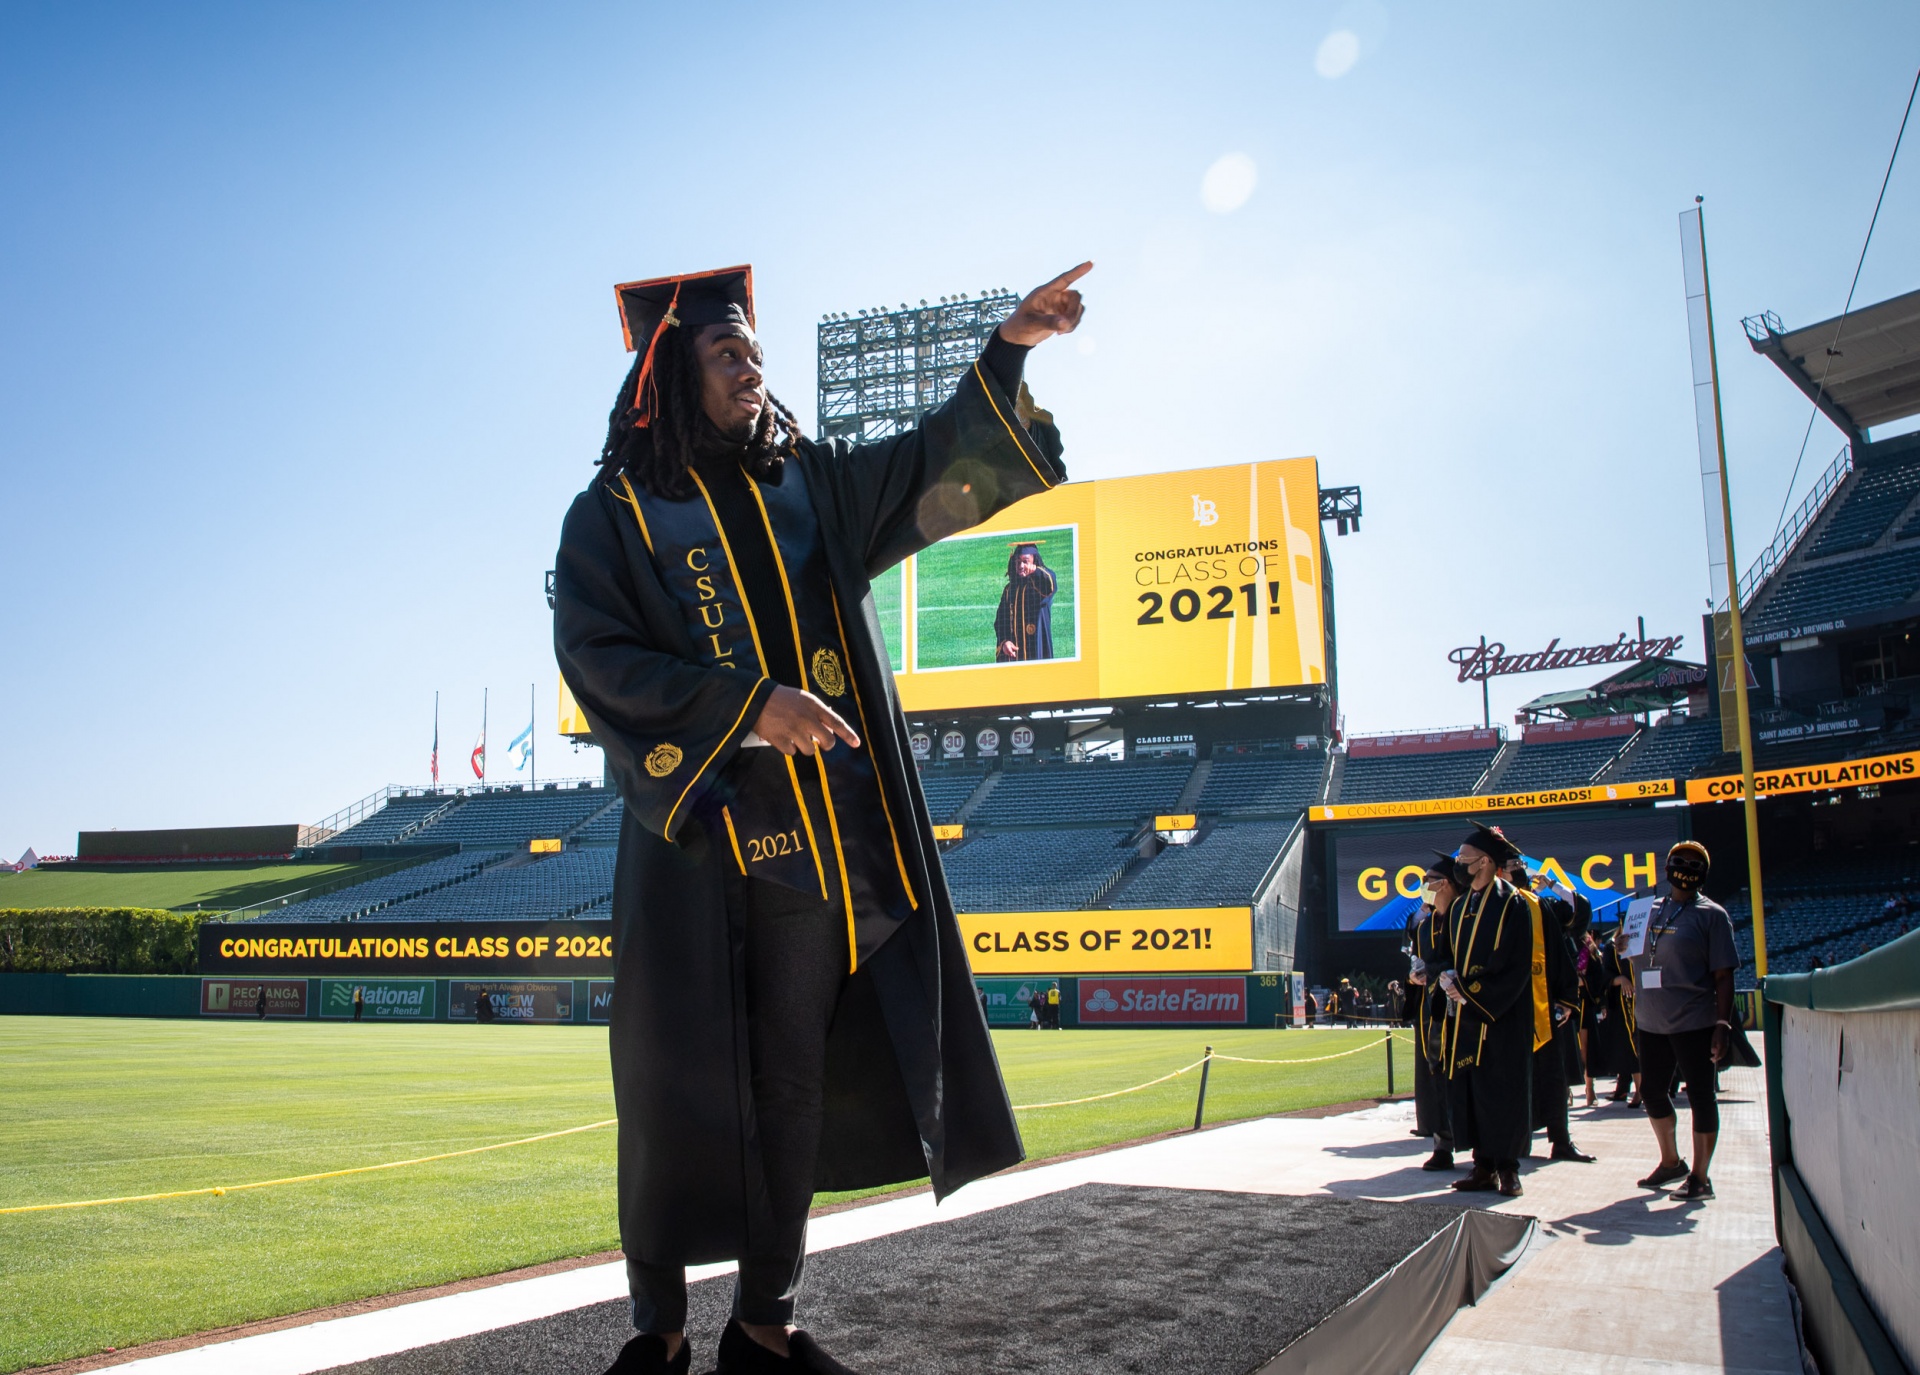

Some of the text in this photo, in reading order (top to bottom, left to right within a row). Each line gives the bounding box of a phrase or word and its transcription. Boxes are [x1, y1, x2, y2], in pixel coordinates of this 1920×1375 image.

[1135, 540, 1279, 562] CONGRATULATIONS
[1135, 554, 1279, 586] CLASS OF
[687, 548, 736, 669] CSUL
[1137, 581, 1280, 625] 2021!
[1745, 636, 1763, 646] SAINT
[1764, 630, 1789, 642] ARCHER
[1803, 624, 1833, 635] BREWING
[1448, 632, 1684, 682] Budweiser
[979, 733, 996, 746] 42
[1014, 731, 1030, 744] 50
[1136, 734, 1194, 744] CLASSIC HITS
[1759, 731, 1776, 740] SAINT
[1777, 727, 1803, 737] ARCHER
[1817, 721, 1847, 732] BREWING
[912, 738, 928, 750] 29
[945, 735, 962, 748] 30
[1347, 798, 1483, 817] CONGRATULATIONS
[1487, 795, 1535, 808] BEACH
[1543, 790, 1592, 804] GRADS!
[1638, 783, 1669, 795] 9:24
[747, 829, 804, 862] 2021
[220, 938, 429, 958] CONGRATULATIONS
[435, 937, 509, 958] CLASS
[515, 936, 549, 957] OF
[974, 928, 1212, 953] CLASS OF 2021!
[464, 983, 480, 991] Pain
[500, 983, 525, 992] Always
[527, 983, 557, 992] Obvious
[1260, 976, 1277, 987] 365
[233, 987, 299, 999] PECANGA
[376, 1006, 421, 1015] Car Rental
[500, 1007, 534, 1018] SIGNS
